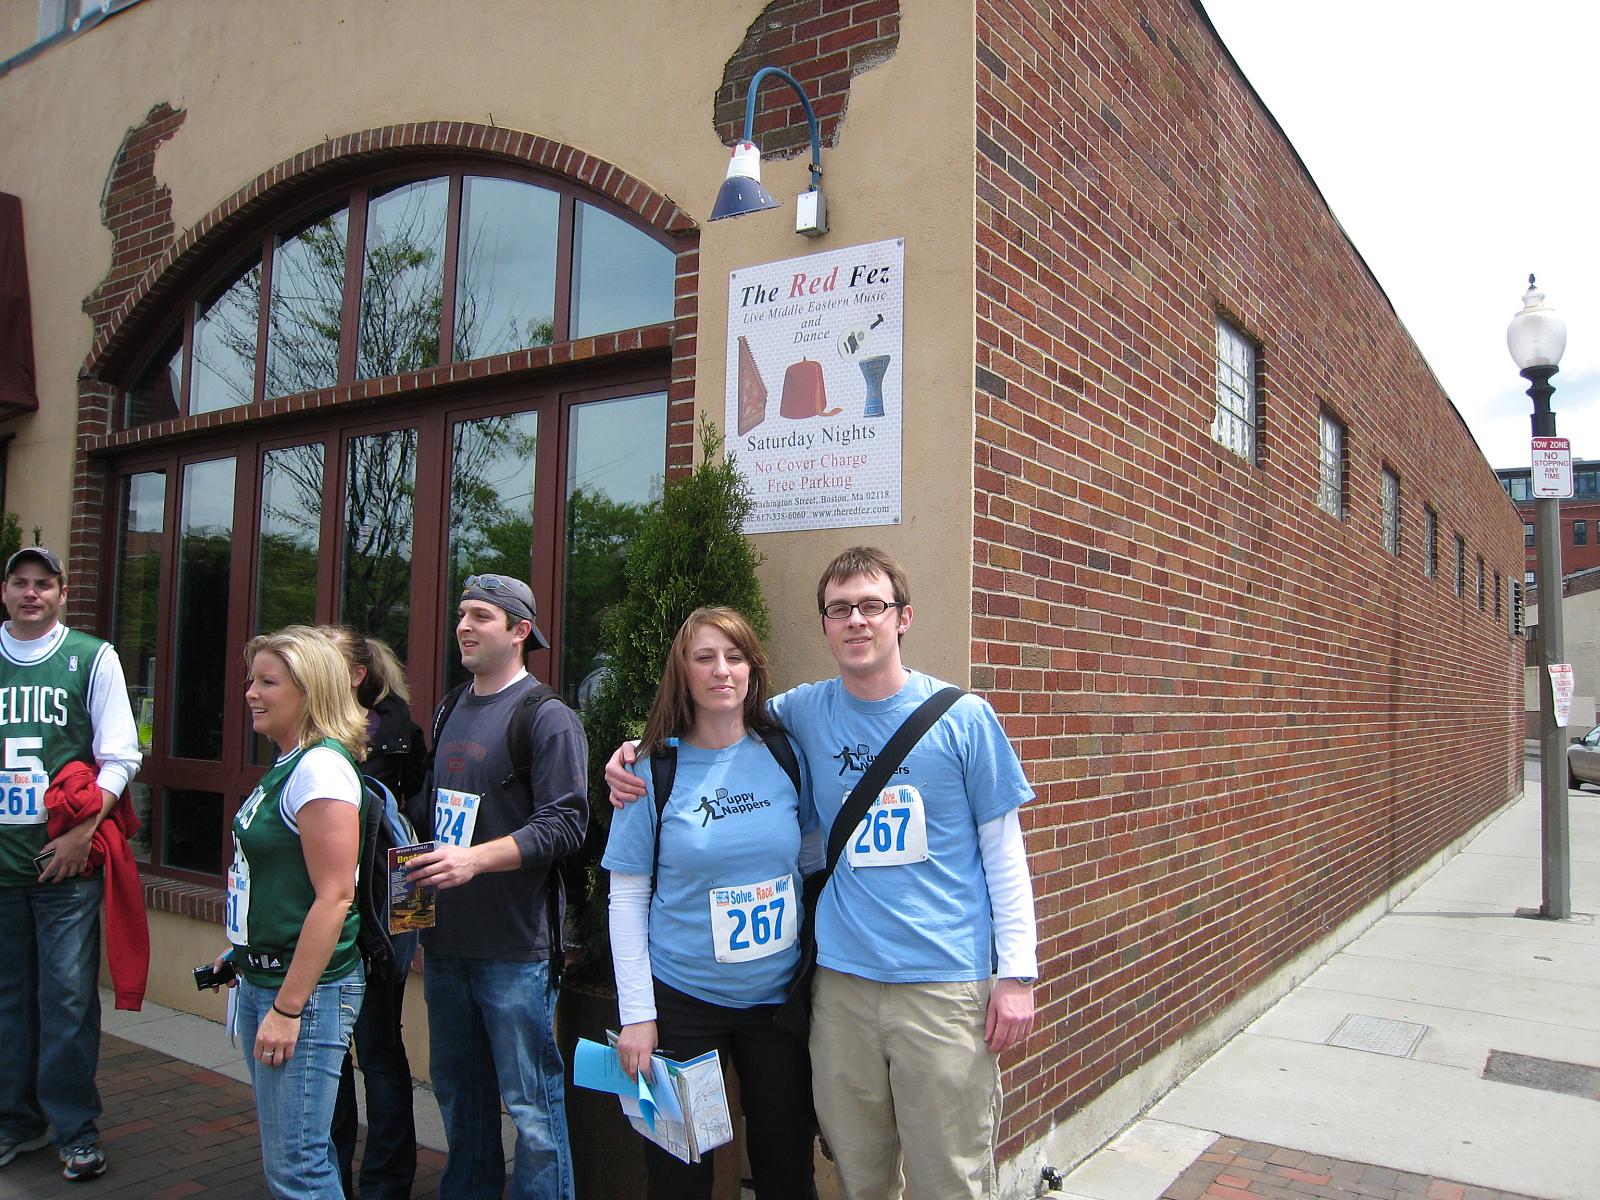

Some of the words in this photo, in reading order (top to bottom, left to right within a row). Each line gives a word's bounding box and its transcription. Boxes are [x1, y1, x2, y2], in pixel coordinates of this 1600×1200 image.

[740, 284, 779, 307] The
[788, 266, 839, 298] Red
[848, 264, 890, 288] Fez
[743, 312, 765, 324] Live
[768, 302, 804, 319] Middle
[807, 298, 849, 313] Eastern
[853, 290, 887, 305] Music
[801, 314, 823, 329] and
[793, 329, 831, 344] Dance
[747, 430, 815, 452] Saturday
[821, 424, 876, 446] Nights
[754, 460, 773, 475] No
[777, 457, 816, 472] Cover
[820, 452, 868, 468] Charge
[1544, 452, 1558, 460] NO
[767, 478, 795, 492] Free
[800, 472, 852, 491] Parking
[866, 490, 890, 500] 02118
[812, 505, 889, 518] www.theredfez.com
[721, 799, 772, 816] Nappers
[434, 806, 466, 846] 224
[854, 807, 911, 854] 267
[730, 889, 755, 905] Solve.
[756, 885, 775, 901] Race.
[775, 878, 789, 893] Win!
[727, 897, 785, 951] 267
